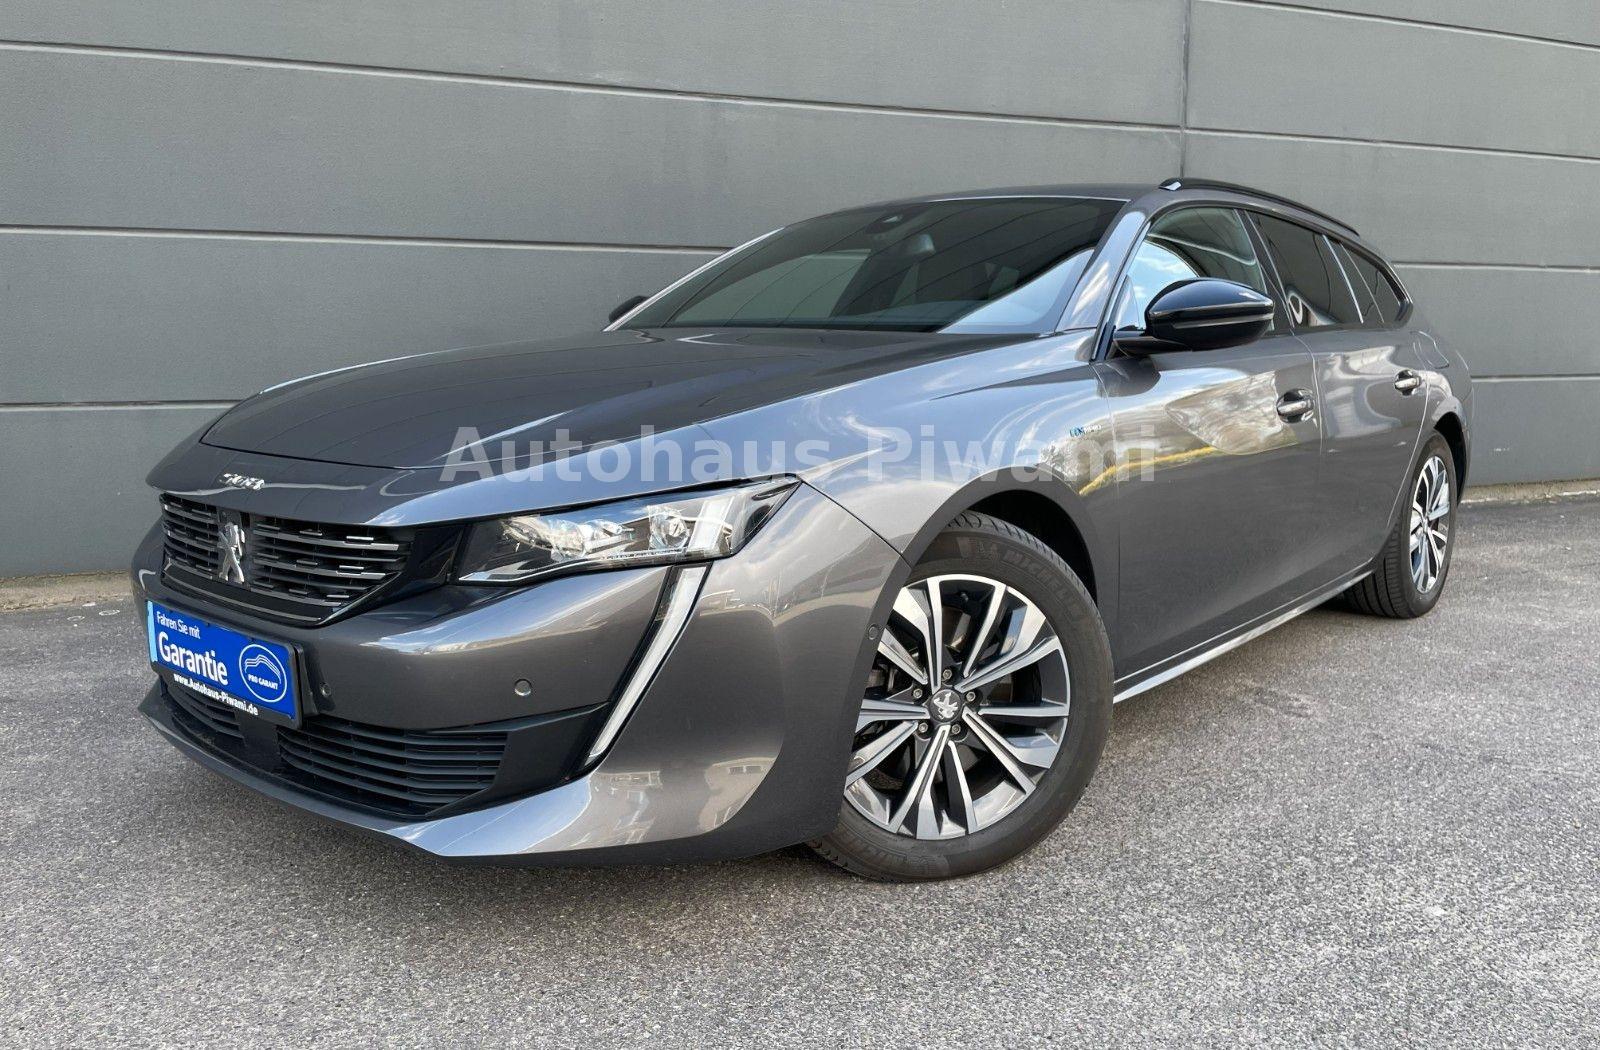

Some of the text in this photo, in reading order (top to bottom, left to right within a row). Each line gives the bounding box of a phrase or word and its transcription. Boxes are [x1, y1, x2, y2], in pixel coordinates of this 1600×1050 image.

[156, 610, 201, 640] Fahren Sie mit
[158, 631, 229, 686] Garantie
[173, 673, 259, 716] www.Autohaus-Piwami.de
[258, 677, 279, 690] GARANT
